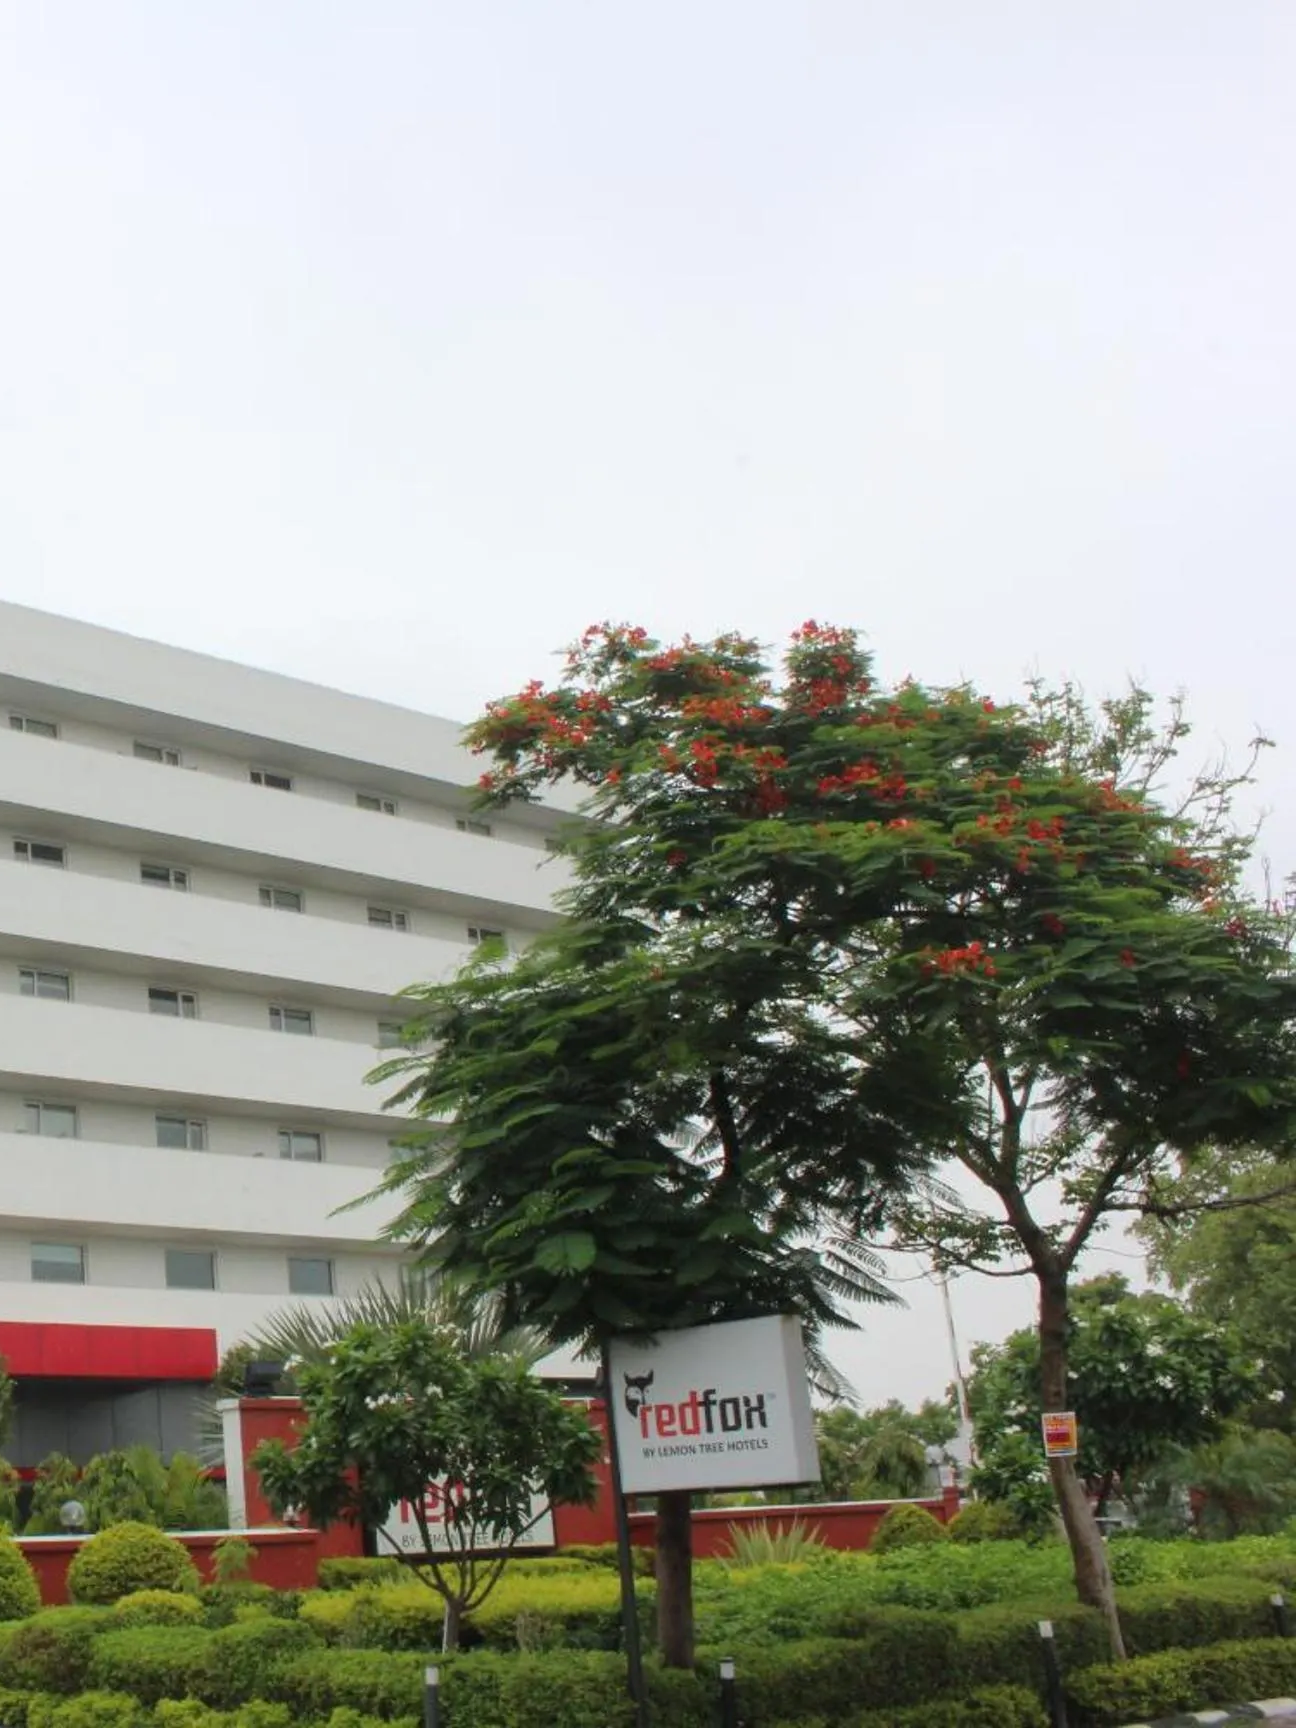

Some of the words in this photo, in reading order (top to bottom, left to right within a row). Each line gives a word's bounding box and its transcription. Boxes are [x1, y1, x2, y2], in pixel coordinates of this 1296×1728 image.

[639, 1388, 768, 1439] redfox
[642, 1447, 655, 1459] BY
[657, 1444, 696, 1458] LEMON
[699, 1441, 724, 1454] TREE
[727, 1438, 769, 1452] HOTELS
